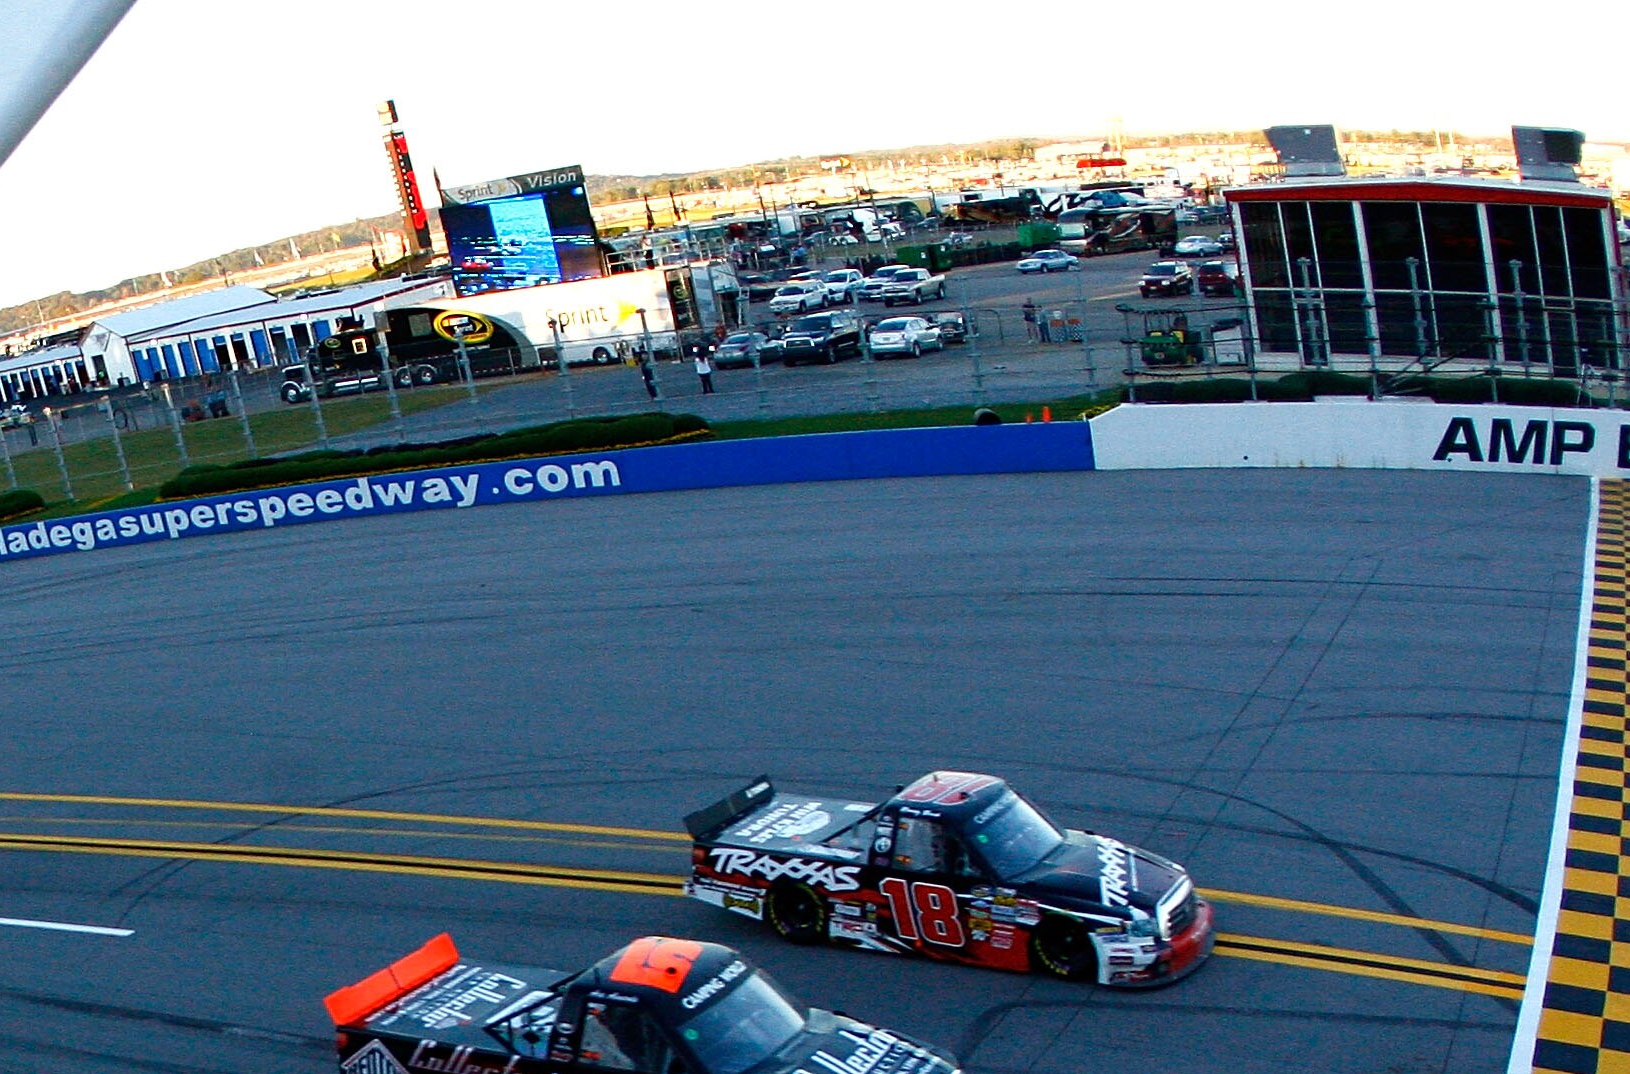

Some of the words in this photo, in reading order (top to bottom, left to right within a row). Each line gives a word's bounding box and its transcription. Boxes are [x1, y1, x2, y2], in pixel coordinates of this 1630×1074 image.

[458, 184, 493, 200] Sprint
[527, 171, 577, 188] Vision
[546, 305, 609, 332] Sprint
[1433, 417, 1596, 466] AMP
[710, 848, 862, 892] TRAXXAS
[880, 878, 965, 948] 18
